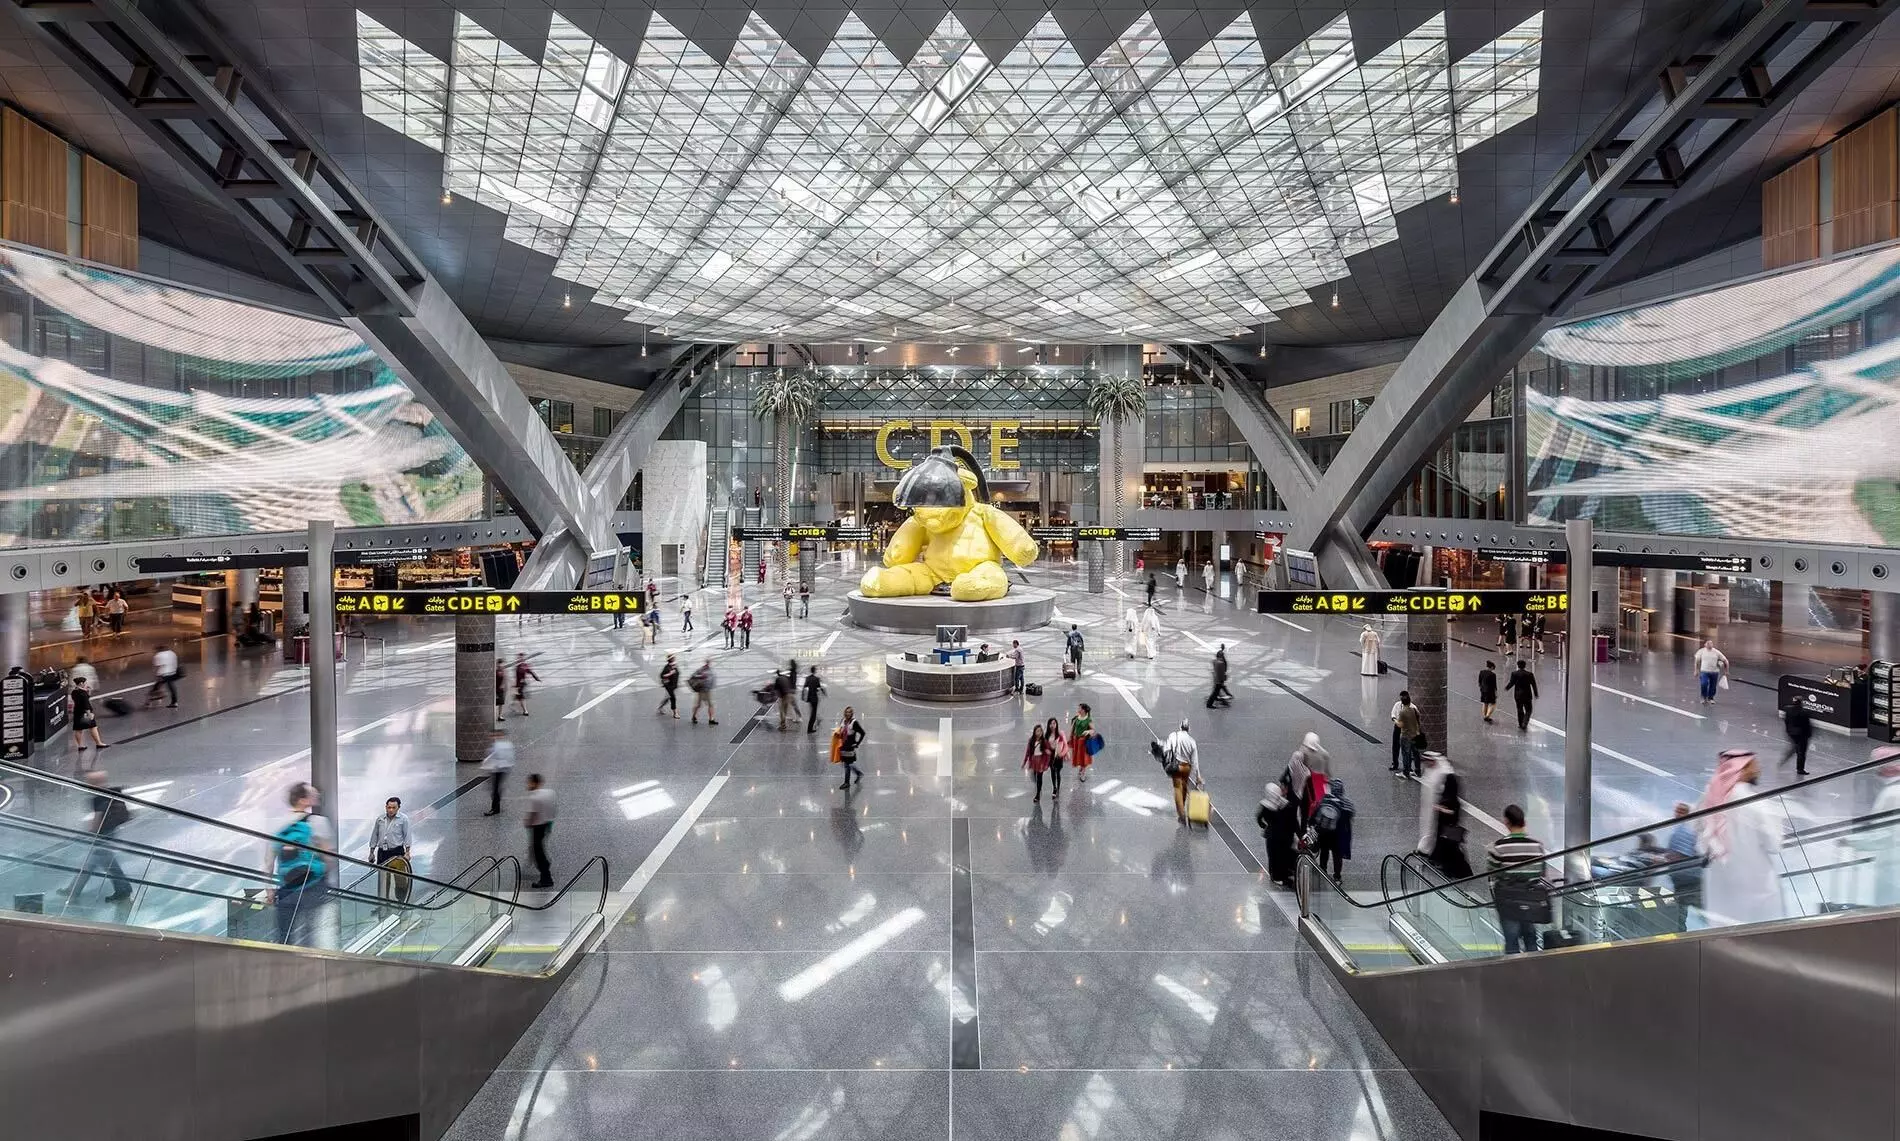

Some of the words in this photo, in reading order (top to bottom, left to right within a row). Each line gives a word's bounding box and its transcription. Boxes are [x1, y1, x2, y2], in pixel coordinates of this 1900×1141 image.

[336, 603, 356, 611] Gates
[359, 597, 371, 610] A
[425, 603, 446, 611] Gates
[568, 603, 589, 611] Gates
[591, 596, 602, 610] B
[1292, 603, 1313, 611] Gates
[1316, 596, 1329, 610] A
[1386, 603, 1408, 611] Gates
[1525, 603, 1546, 611] Gates
[1547, 596, 1557, 609] B
